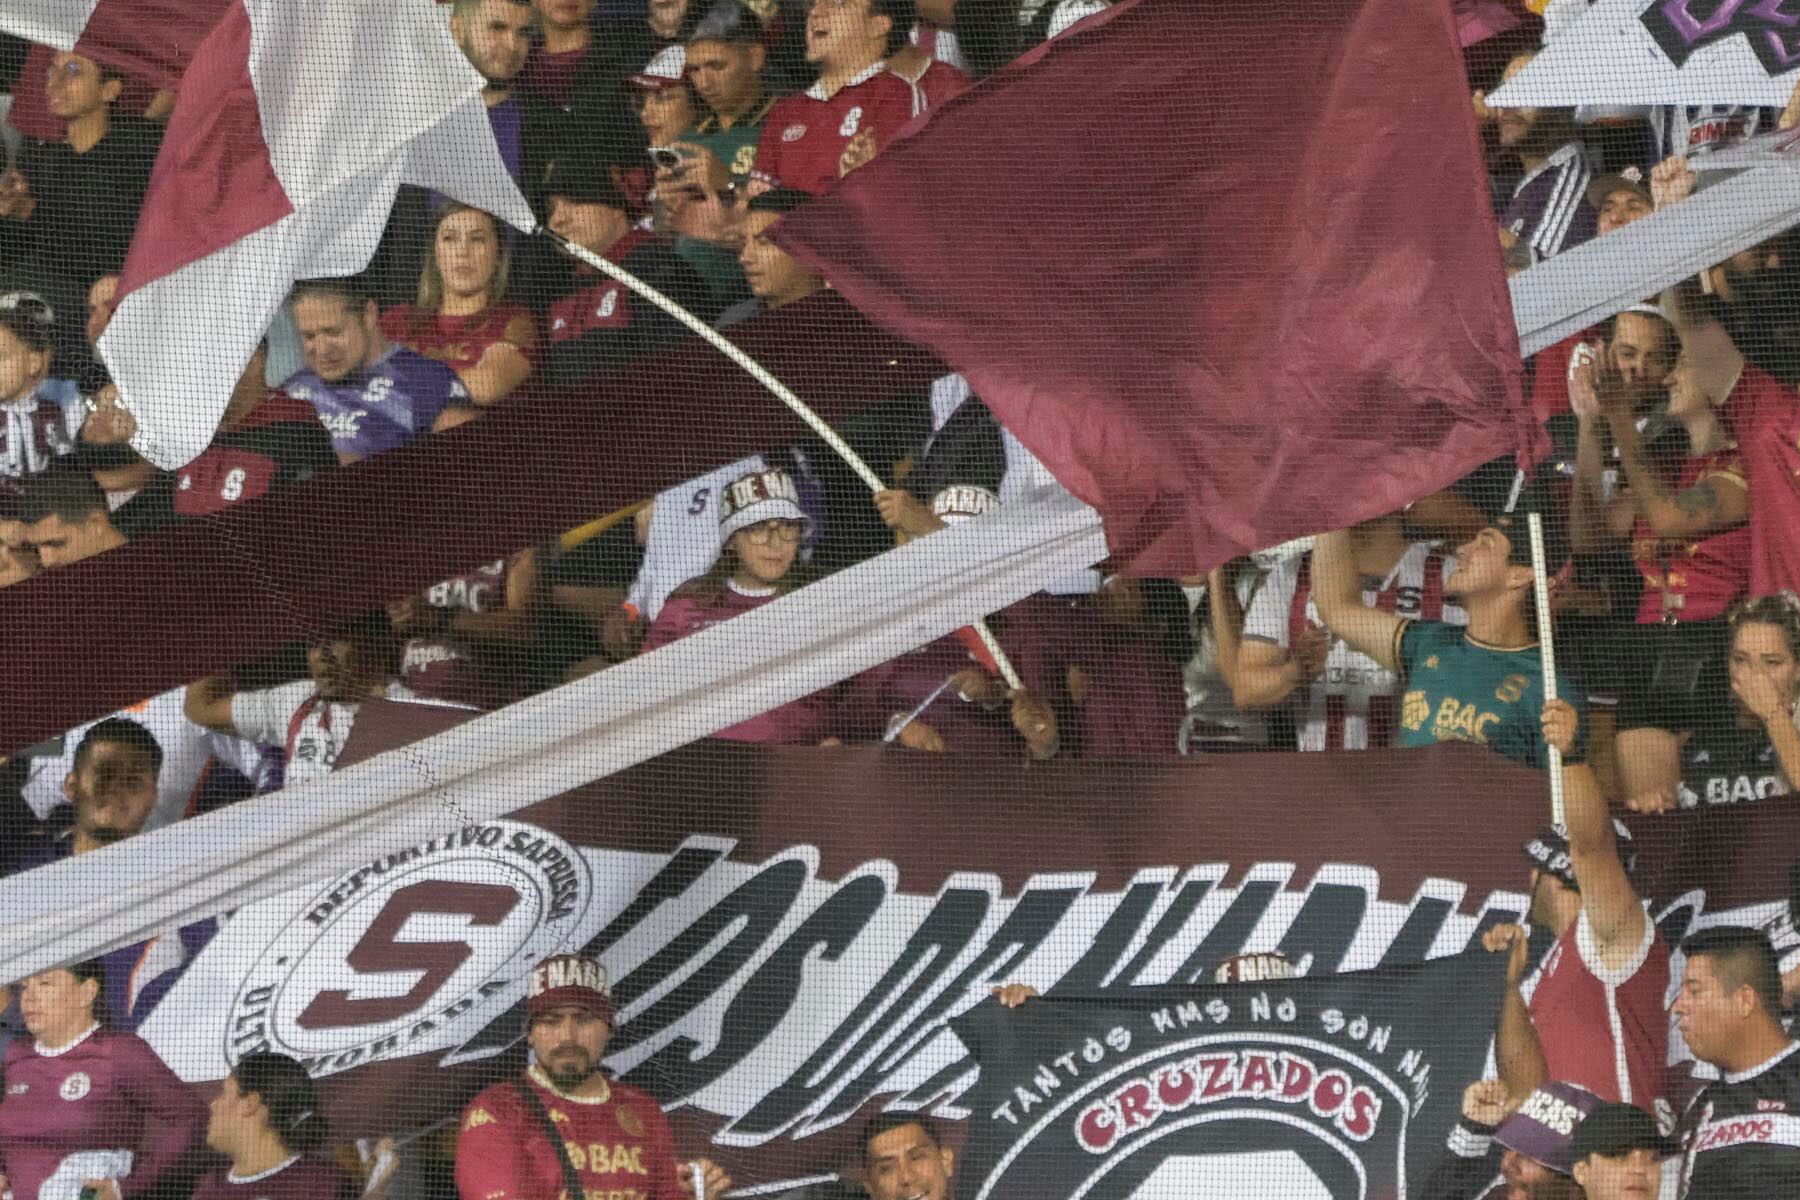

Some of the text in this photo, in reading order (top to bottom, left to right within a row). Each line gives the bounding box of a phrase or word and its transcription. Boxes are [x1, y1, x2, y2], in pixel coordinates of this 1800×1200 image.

[360, 377, 393, 403] S
[306, 826, 580, 927] DEPORTIVO SAPRISSA
[295, 878, 522, 1030] S
[992, 1025, 1133, 1125] TANTOS
[1150, 999, 1231, 1034] KMS
[1250, 992, 1297, 1023] NO
[1320, 1008, 1393, 1056] SON
[1074, 1049, 1383, 1155] CRUZADOS
[589, 1143, 649, 1176] BAC
